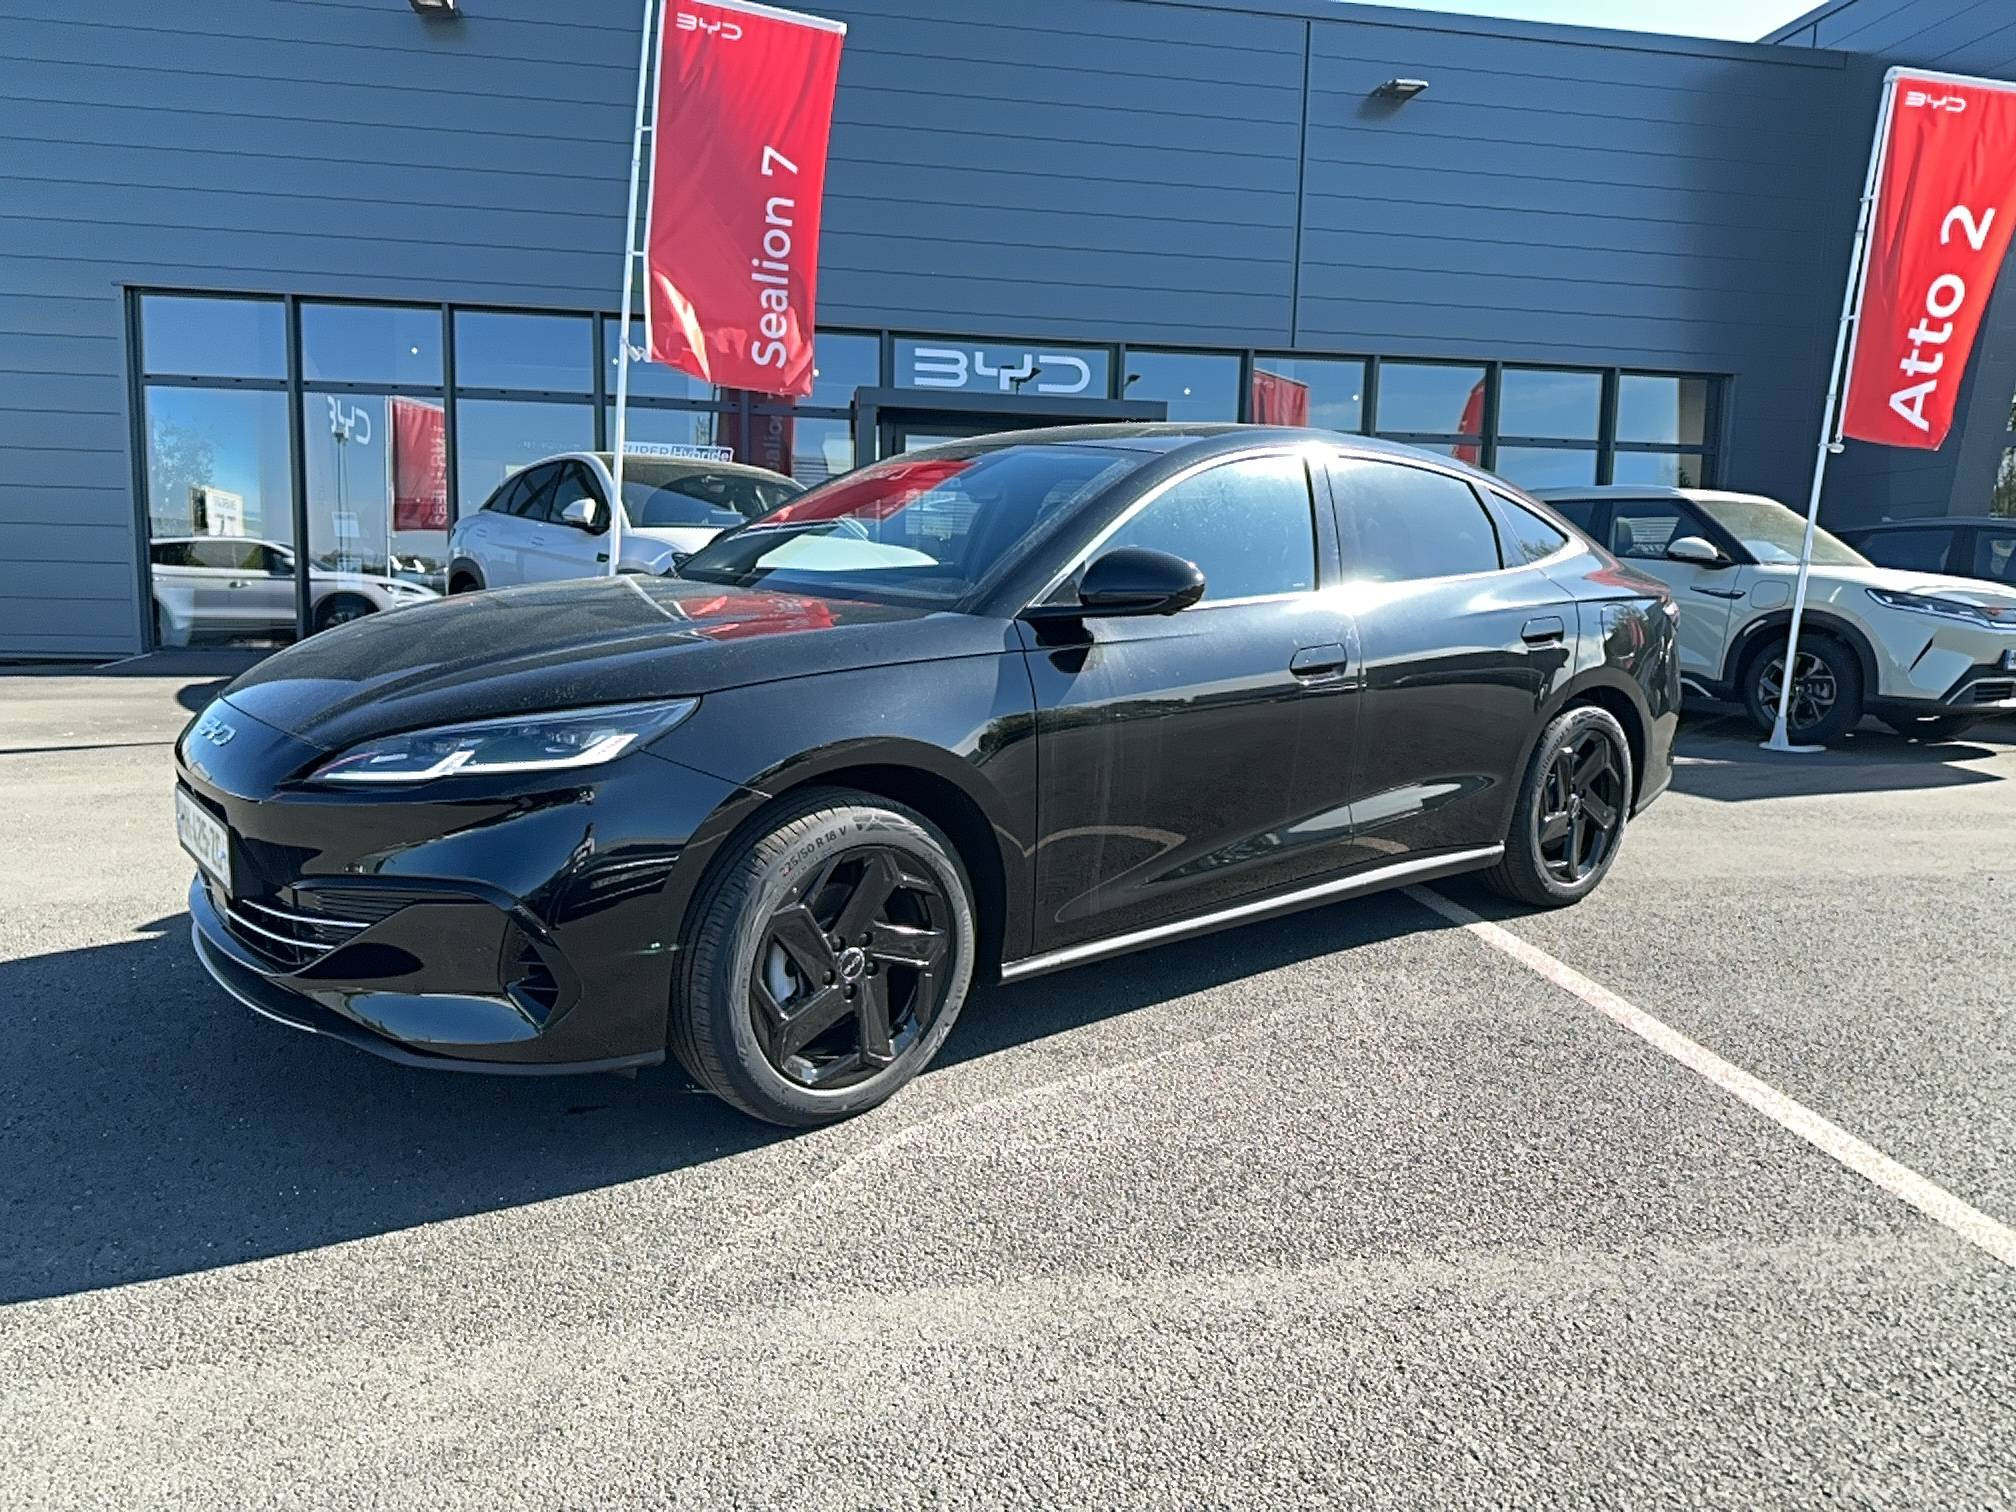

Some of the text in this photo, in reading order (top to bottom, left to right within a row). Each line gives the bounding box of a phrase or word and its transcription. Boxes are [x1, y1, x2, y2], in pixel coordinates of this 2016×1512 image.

[676, 12, 743, 40] BYD
[1905, 91, 1966, 113] BYD
[752, 145, 798, 368] Sealion 7
[1889, 205, 1996, 432] Atto 2
[914, 347, 1091, 393] BYD
[815, 837, 825, 849] R
[839, 825, 846, 836] V
